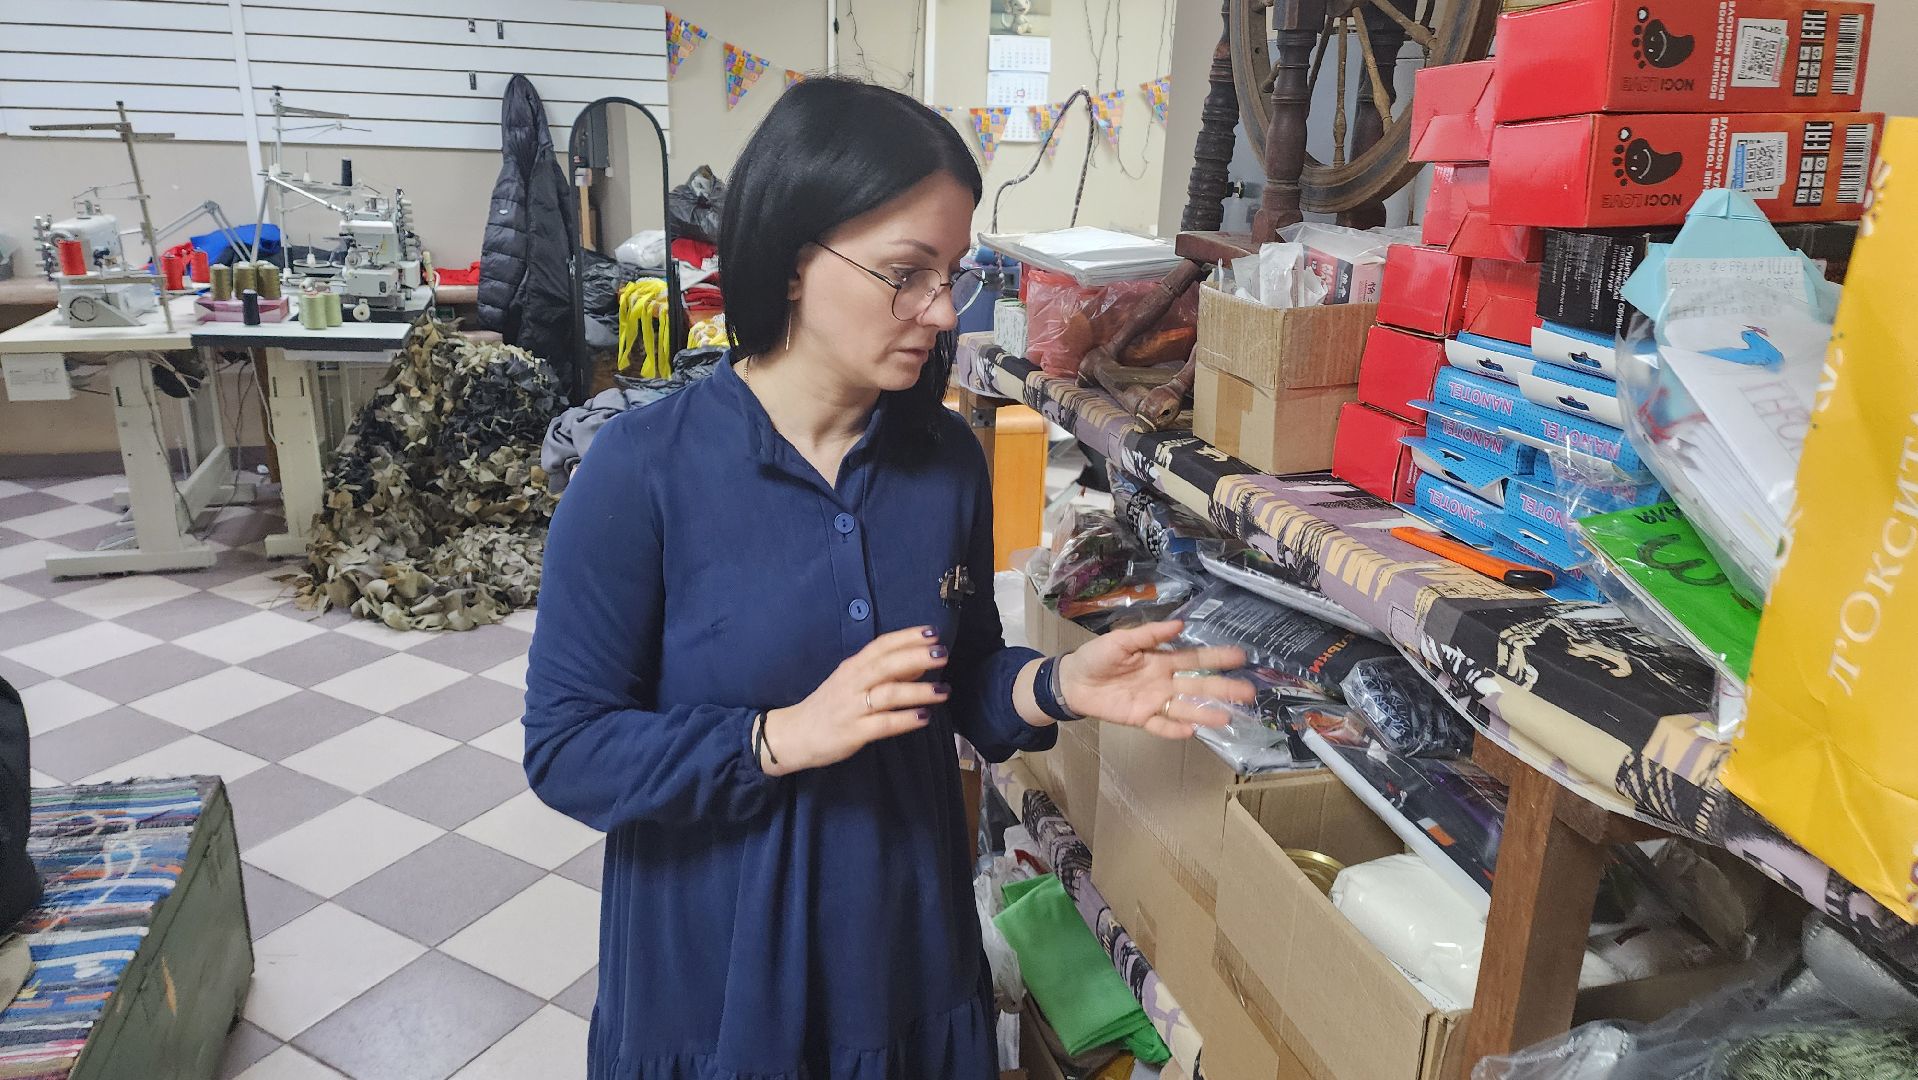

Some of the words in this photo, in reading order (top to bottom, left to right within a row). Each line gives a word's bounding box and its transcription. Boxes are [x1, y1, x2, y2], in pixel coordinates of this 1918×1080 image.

[1715, 1, 1728, 57] ТОВАРОВ
[1709, 58, 1722, 100] БОЛЬШЕ
[1717, 63, 1729, 101] БРЕНДА
[1705, 117, 1720, 166] ТОВАРОВ
[1716, 116, 1729, 171] NOGILOVE
[1449, 381, 1514, 416] NANOTEL
[1441, 417, 1503, 454] NANOTEL
[1541, 419, 1622, 461] NANOTEL
[1519, 493, 1568, 531] NOTEL
